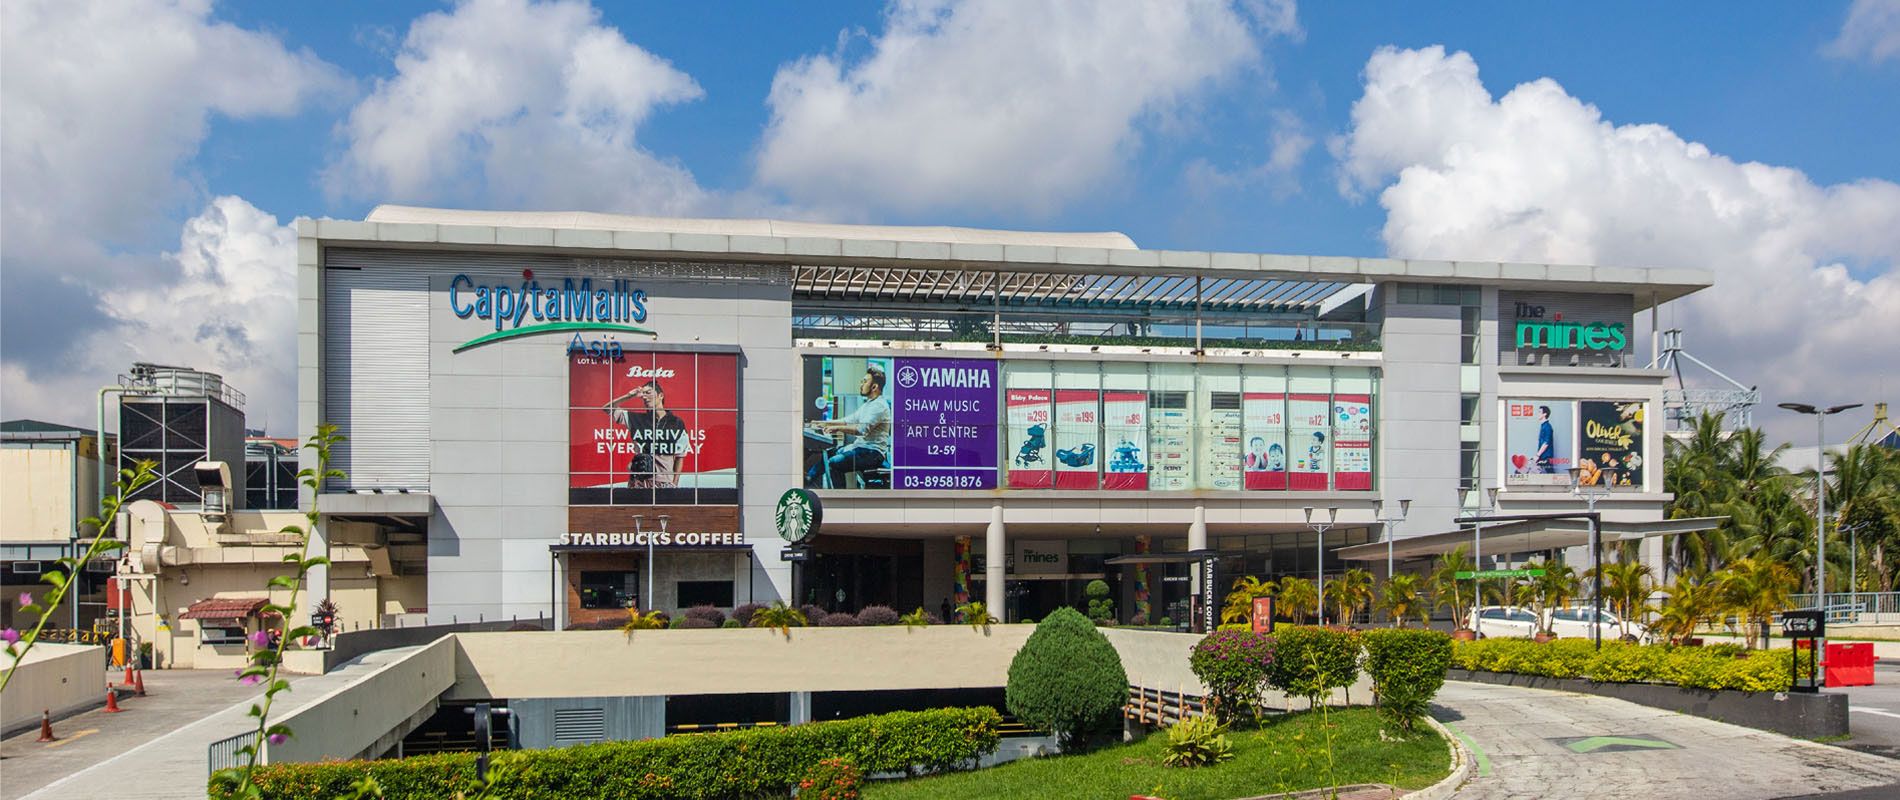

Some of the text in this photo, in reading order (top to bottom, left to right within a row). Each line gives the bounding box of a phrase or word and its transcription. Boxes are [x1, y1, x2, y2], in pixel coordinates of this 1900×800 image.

[450, 268, 648, 331] CapitaMalls
[1515, 301, 1546, 318] The
[1516, 312, 1627, 350] mines
[566, 331, 623, 358] Asia
[626, 365, 676, 379] Bata
[920, 367, 991, 389] YAMAHA
[905, 399, 980, 412] SHAW MUSIC
[939, 413, 947, 425] &
[594, 429, 706, 441] NEW ARRIVALS
[906, 426, 978, 439] ART CENTRE
[597, 442, 704, 454] EVERY FRIDAY
[927, 445, 957, 455] L2-59
[904, 475, 982, 488] 03-89581876
[559, 532, 744, 546] STARBUCKS COFFEE
[1023, 552, 1059, 563] mines
